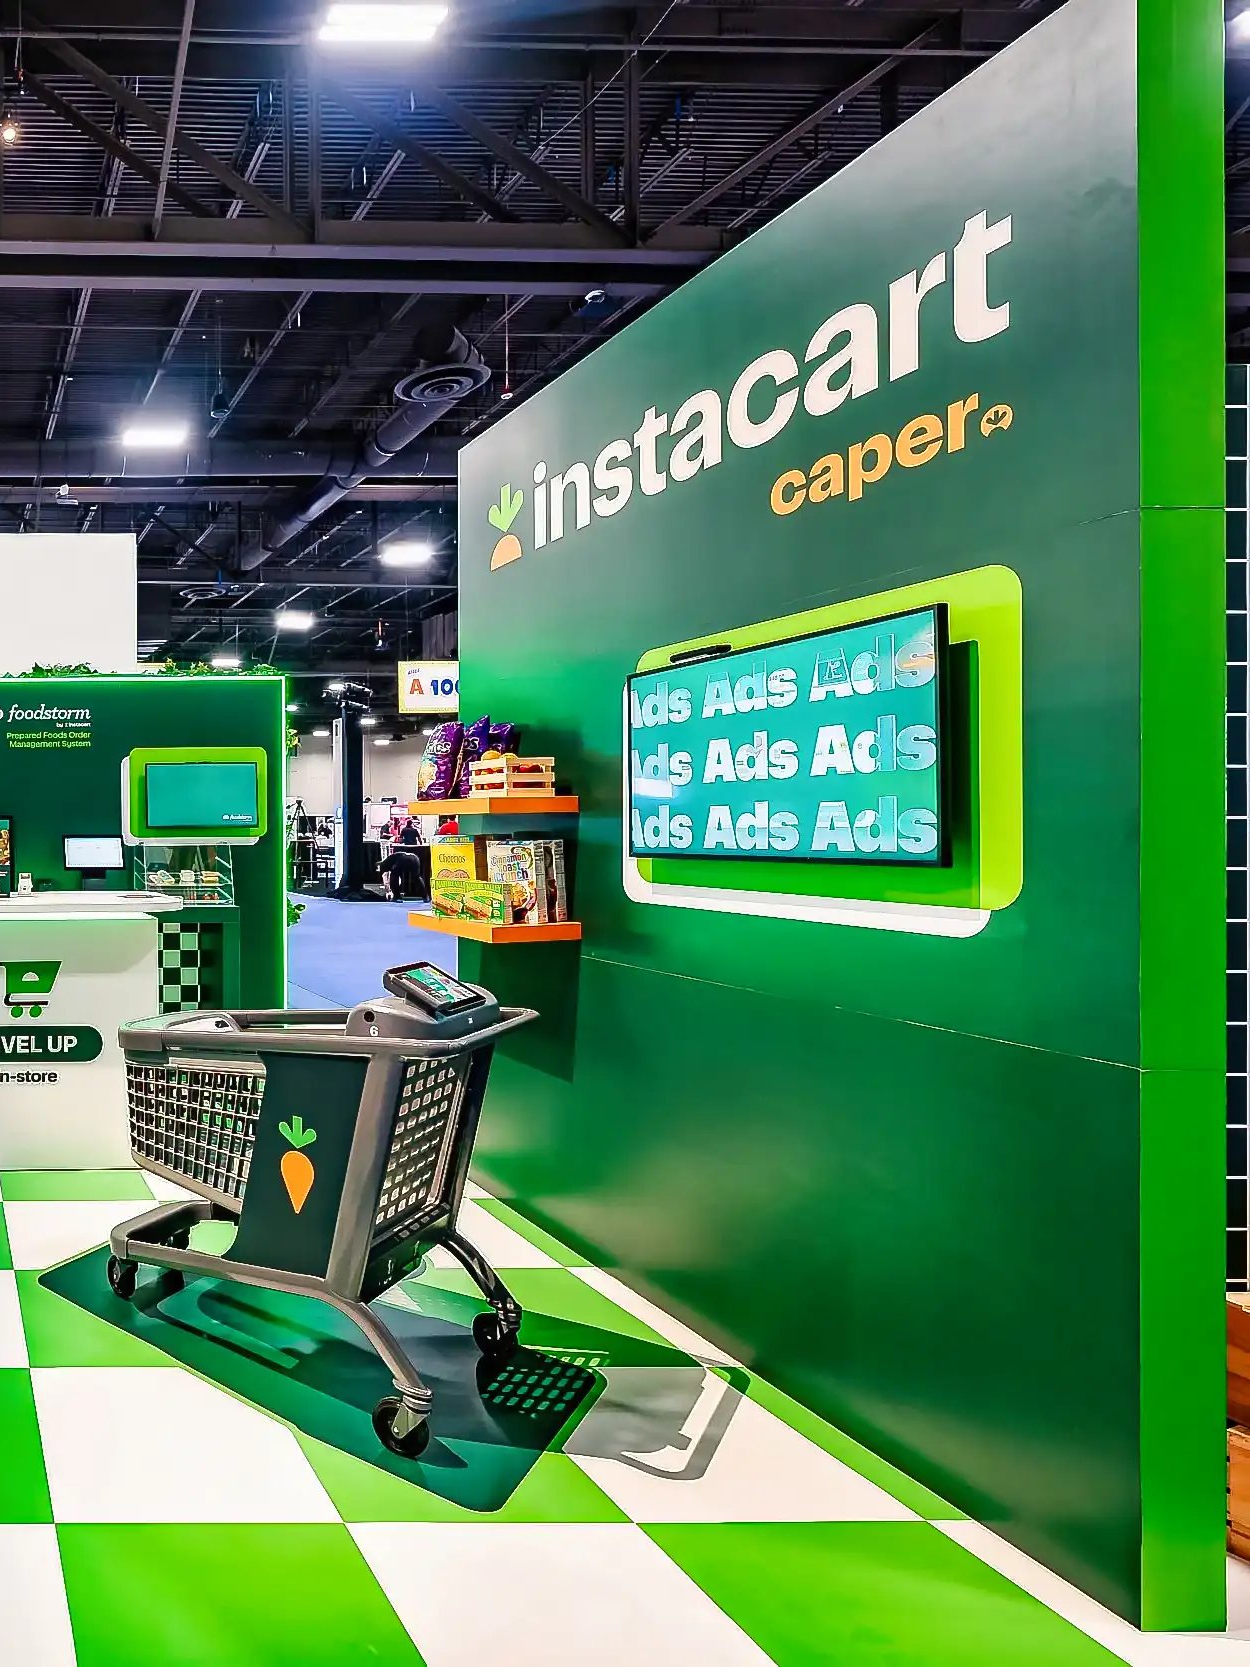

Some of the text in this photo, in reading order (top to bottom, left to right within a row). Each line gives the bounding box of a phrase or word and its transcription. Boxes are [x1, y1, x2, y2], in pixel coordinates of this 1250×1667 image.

[533, 209, 1013, 550] instacart
[770, 393, 980, 516] caper
[701, 660, 798, 719] Ads
[808, 633, 936, 703] Ads
[409, 678, 460, 696] A 10
[7, 703, 92, 722] foodstorm
[6, 731, 91, 740] Prepared Foods Order
[9, 740, 92, 749] Management System
[702, 731, 799, 784] Ads
[810, 715, 937, 777] Ads
[703, 800, 800, 851] Ads
[811, 796, 938, 854] Ads
[369, 1025, 379, 1037] 6
[47, 1035, 78, 1053] UP
